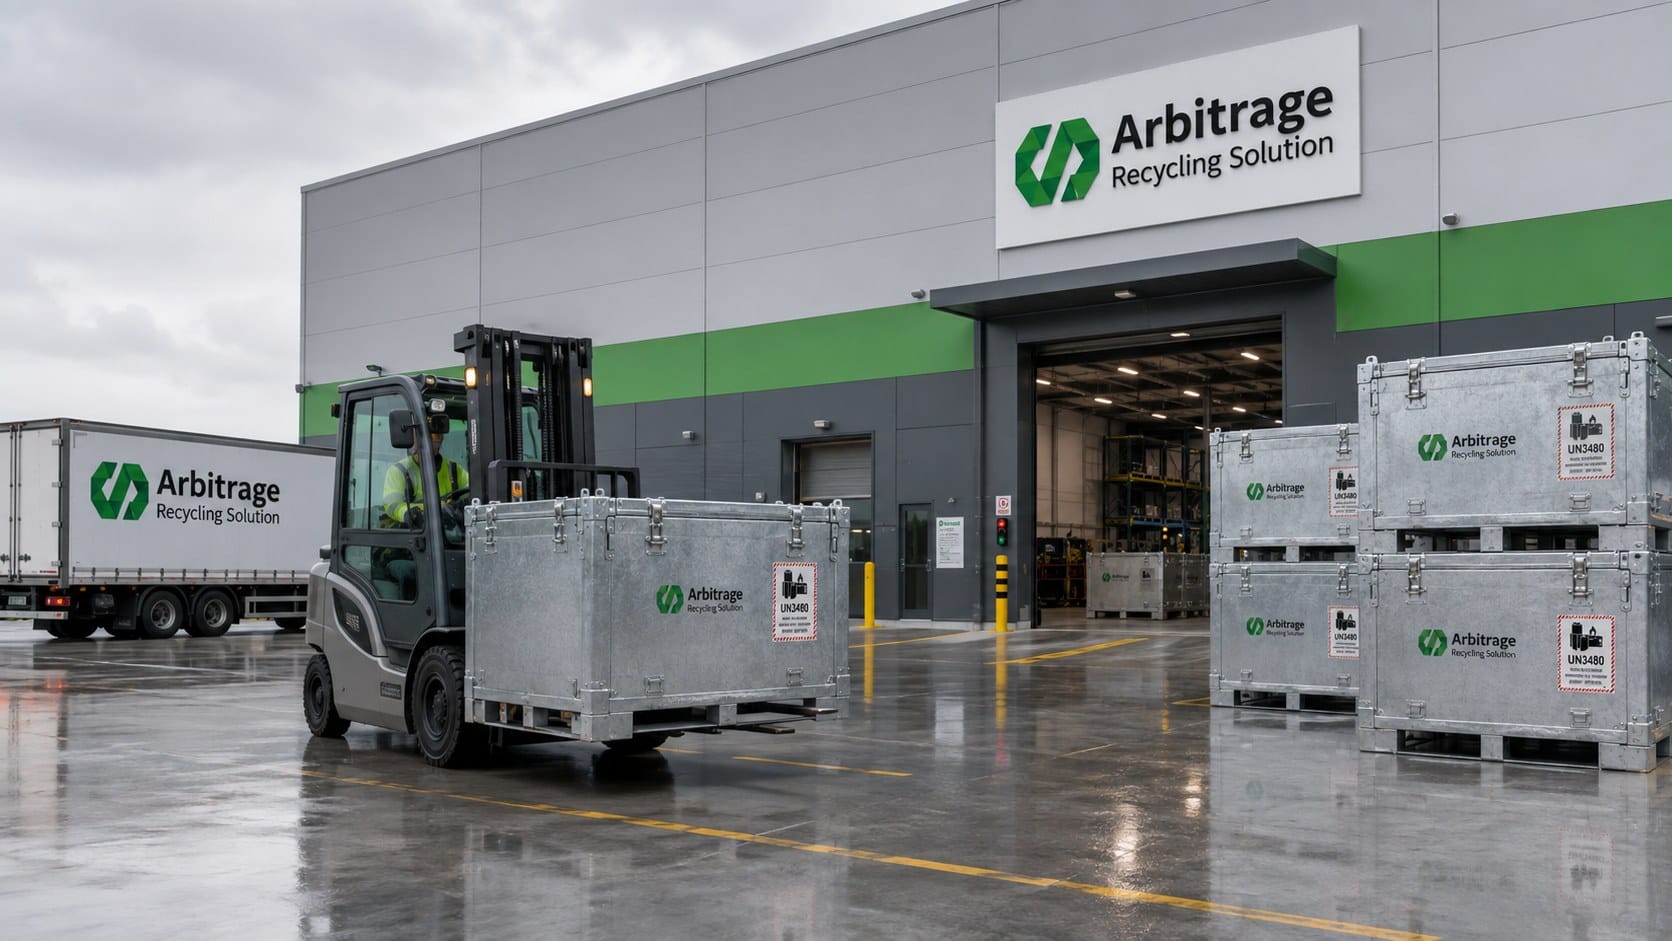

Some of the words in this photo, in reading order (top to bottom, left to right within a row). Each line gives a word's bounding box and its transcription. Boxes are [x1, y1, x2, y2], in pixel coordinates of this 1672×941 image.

[1112, 84, 1334, 153] Arbitrage
[1112, 153, 1222, 188] Recycling
[1229, 135, 1334, 169] Solution
[1451, 433, 1517, 449] Arbitrage
[1451, 450, 1485, 460] Recycling
[1486, 449, 1517, 457] Solution
[1567, 443, 1605, 454] UN3480
[157, 469, 280, 507] Arbitrage
[1266, 483, 1305, 494] Arbitrage
[156, 503, 223, 525] Recycling
[226, 507, 279, 525] Solution
[688, 586, 743, 603] Arbitrage
[687, 604, 717, 614] Recycling
[717, 603, 743, 612] Solution
[1266, 618, 1305, 631] Arbitrage
[1451, 632, 1517, 650] Arbitrage
[1451, 649, 1485, 659] Recycling
[1486, 649, 1517, 659] Solution
[1567, 654, 1605, 666] UN3480
